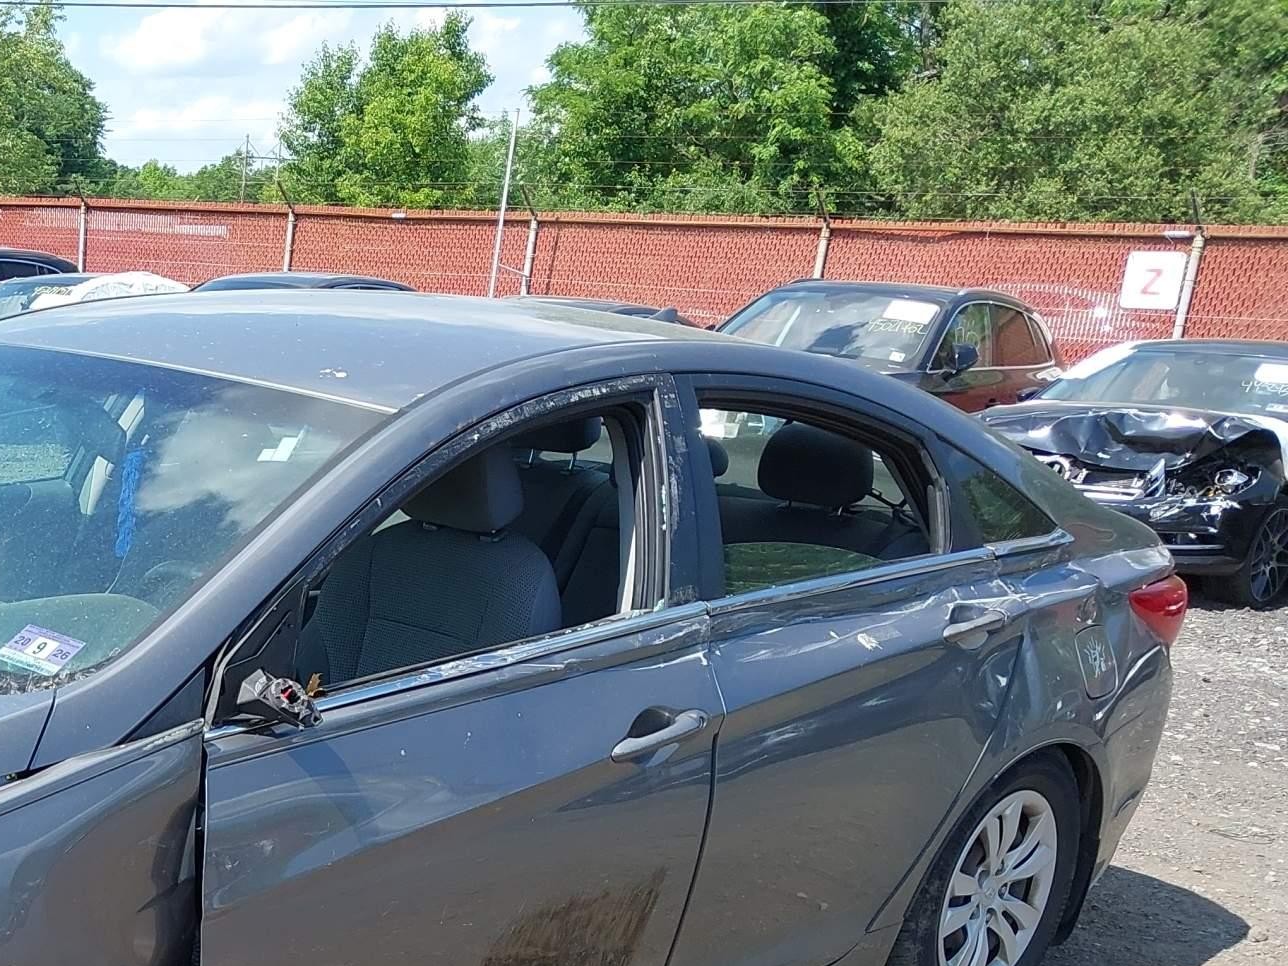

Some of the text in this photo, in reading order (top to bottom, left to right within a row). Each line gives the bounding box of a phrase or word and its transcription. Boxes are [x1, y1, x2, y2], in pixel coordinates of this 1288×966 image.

[1140, 268, 1164, 295] Z
[13, 635, 71, 660] 20 9 26
